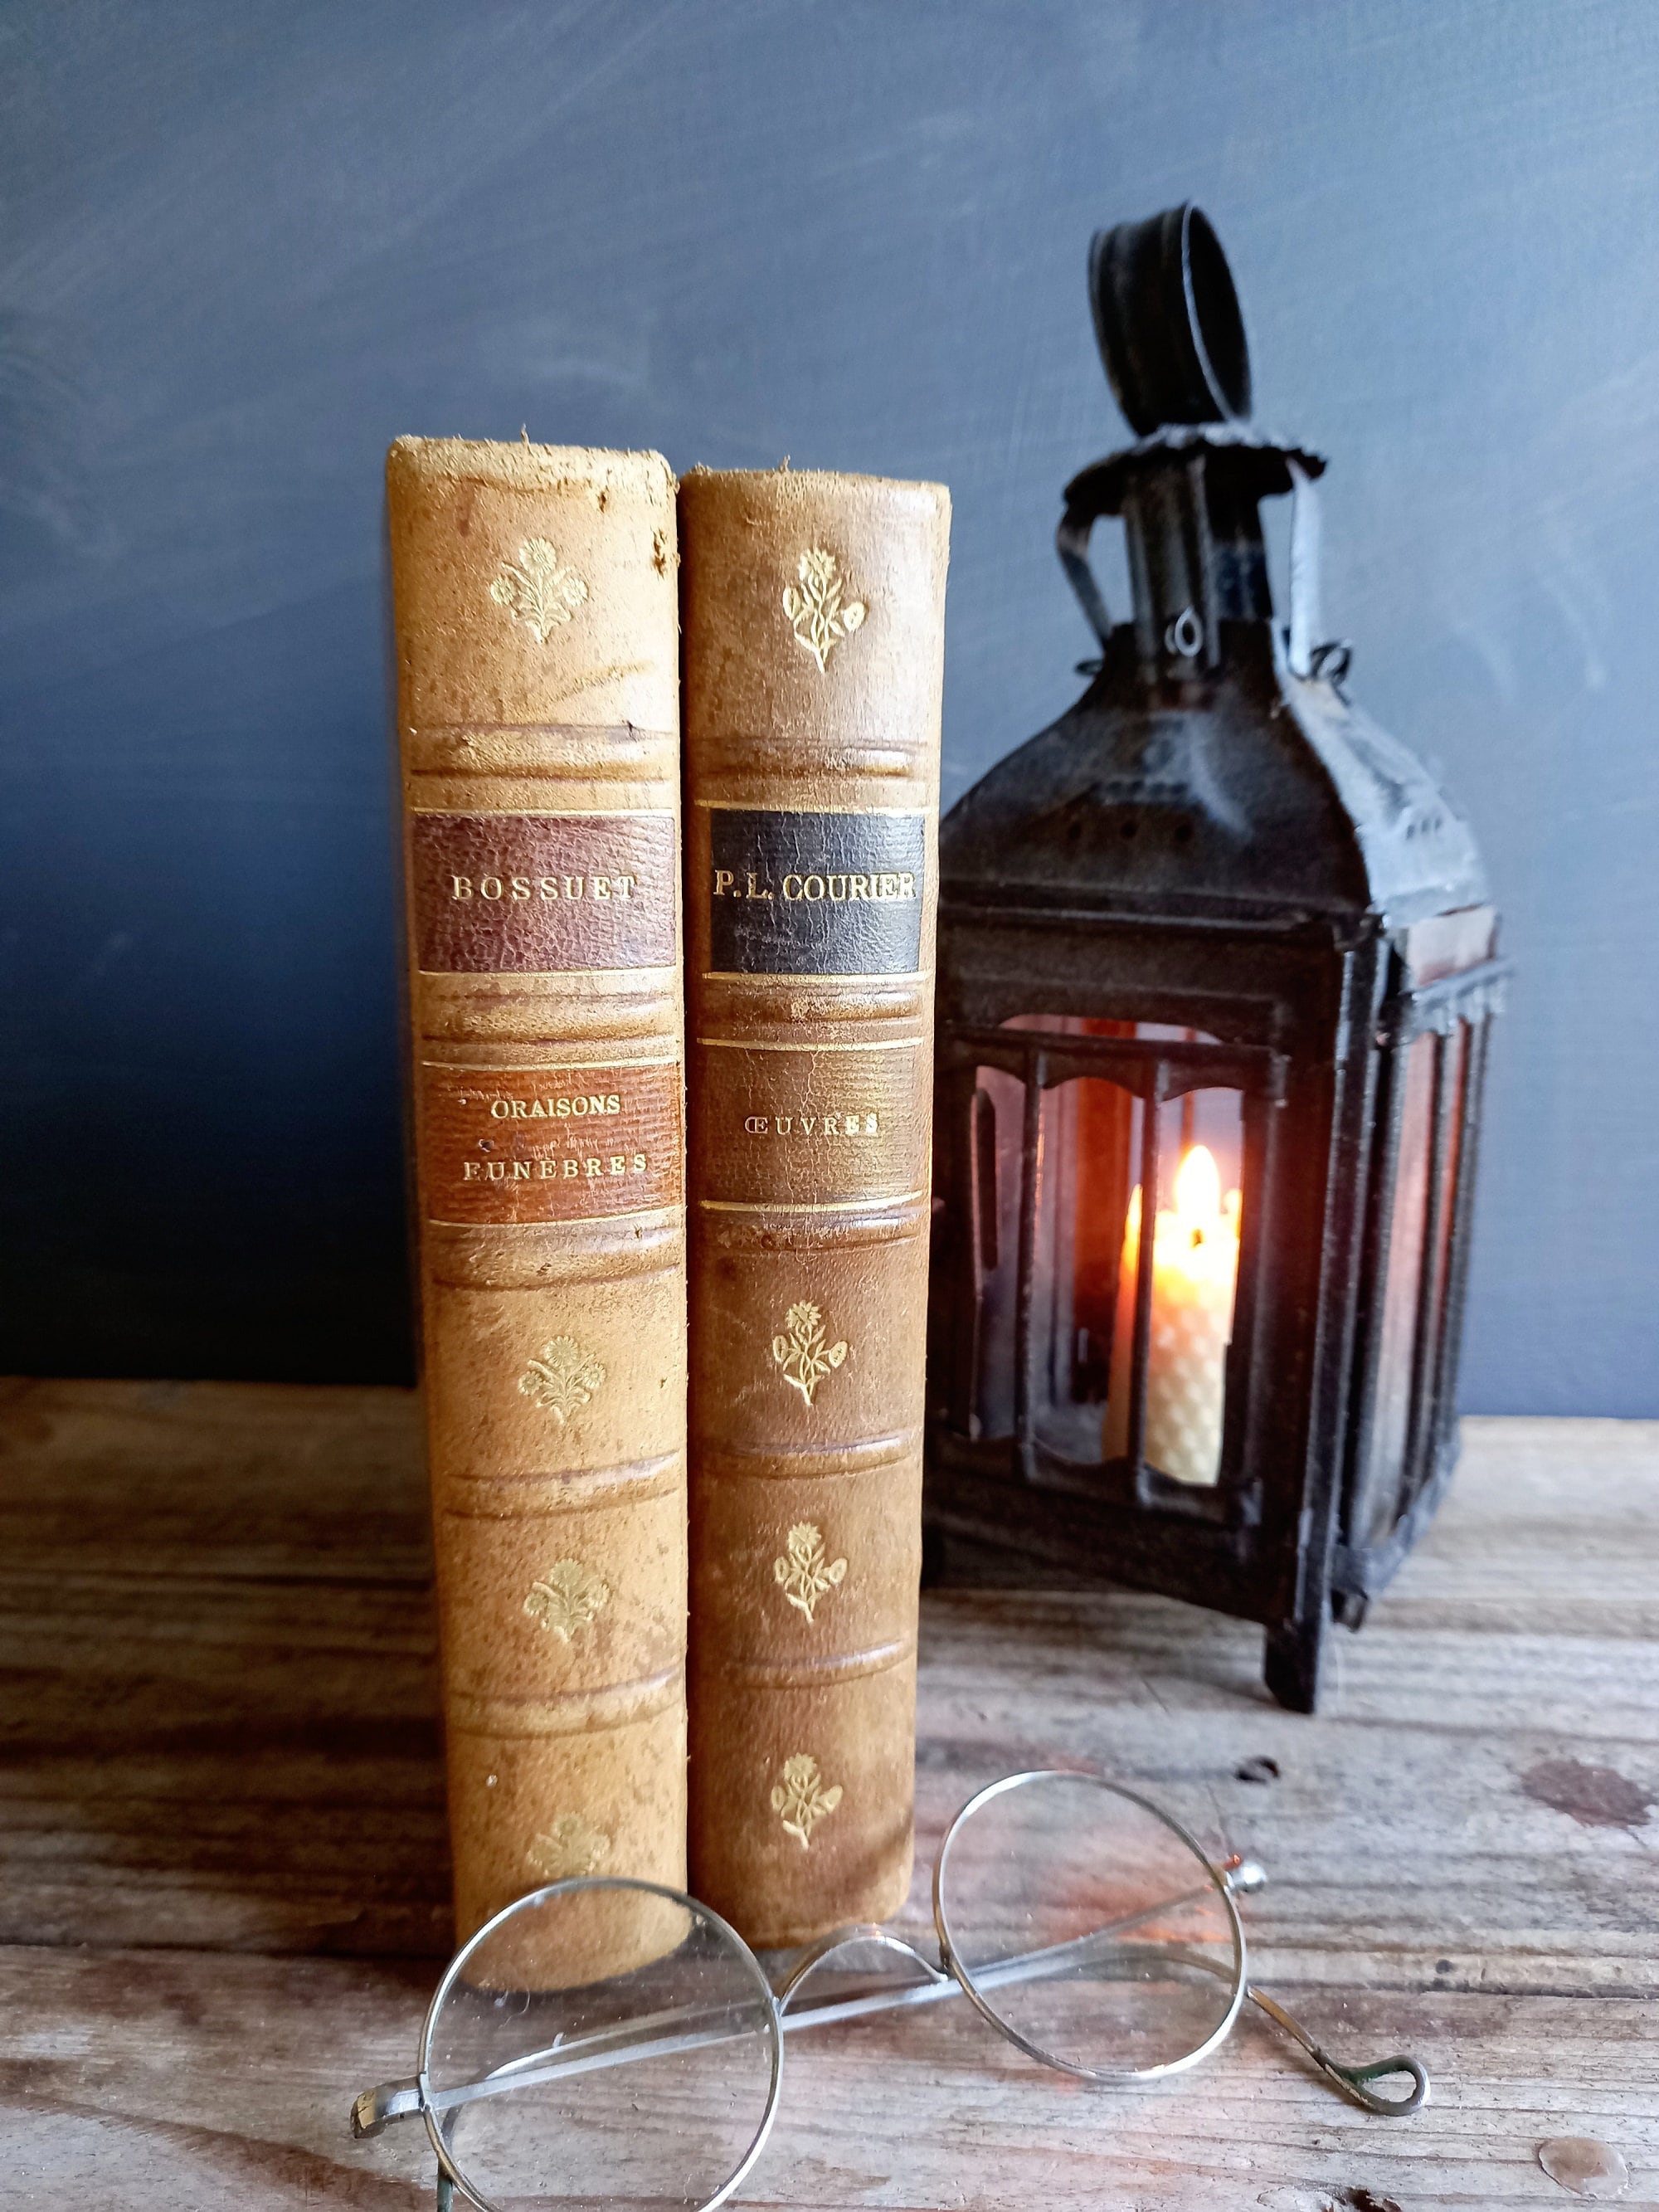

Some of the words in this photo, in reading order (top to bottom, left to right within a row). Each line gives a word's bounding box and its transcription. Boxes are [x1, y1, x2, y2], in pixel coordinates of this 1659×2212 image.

[451, 875, 638, 900] BOSSUET
[782, 872, 916, 900] COURIER
[491, 1094, 620, 1118] ORAISONS
[745, 1113, 878, 1136] ŒUVRES
